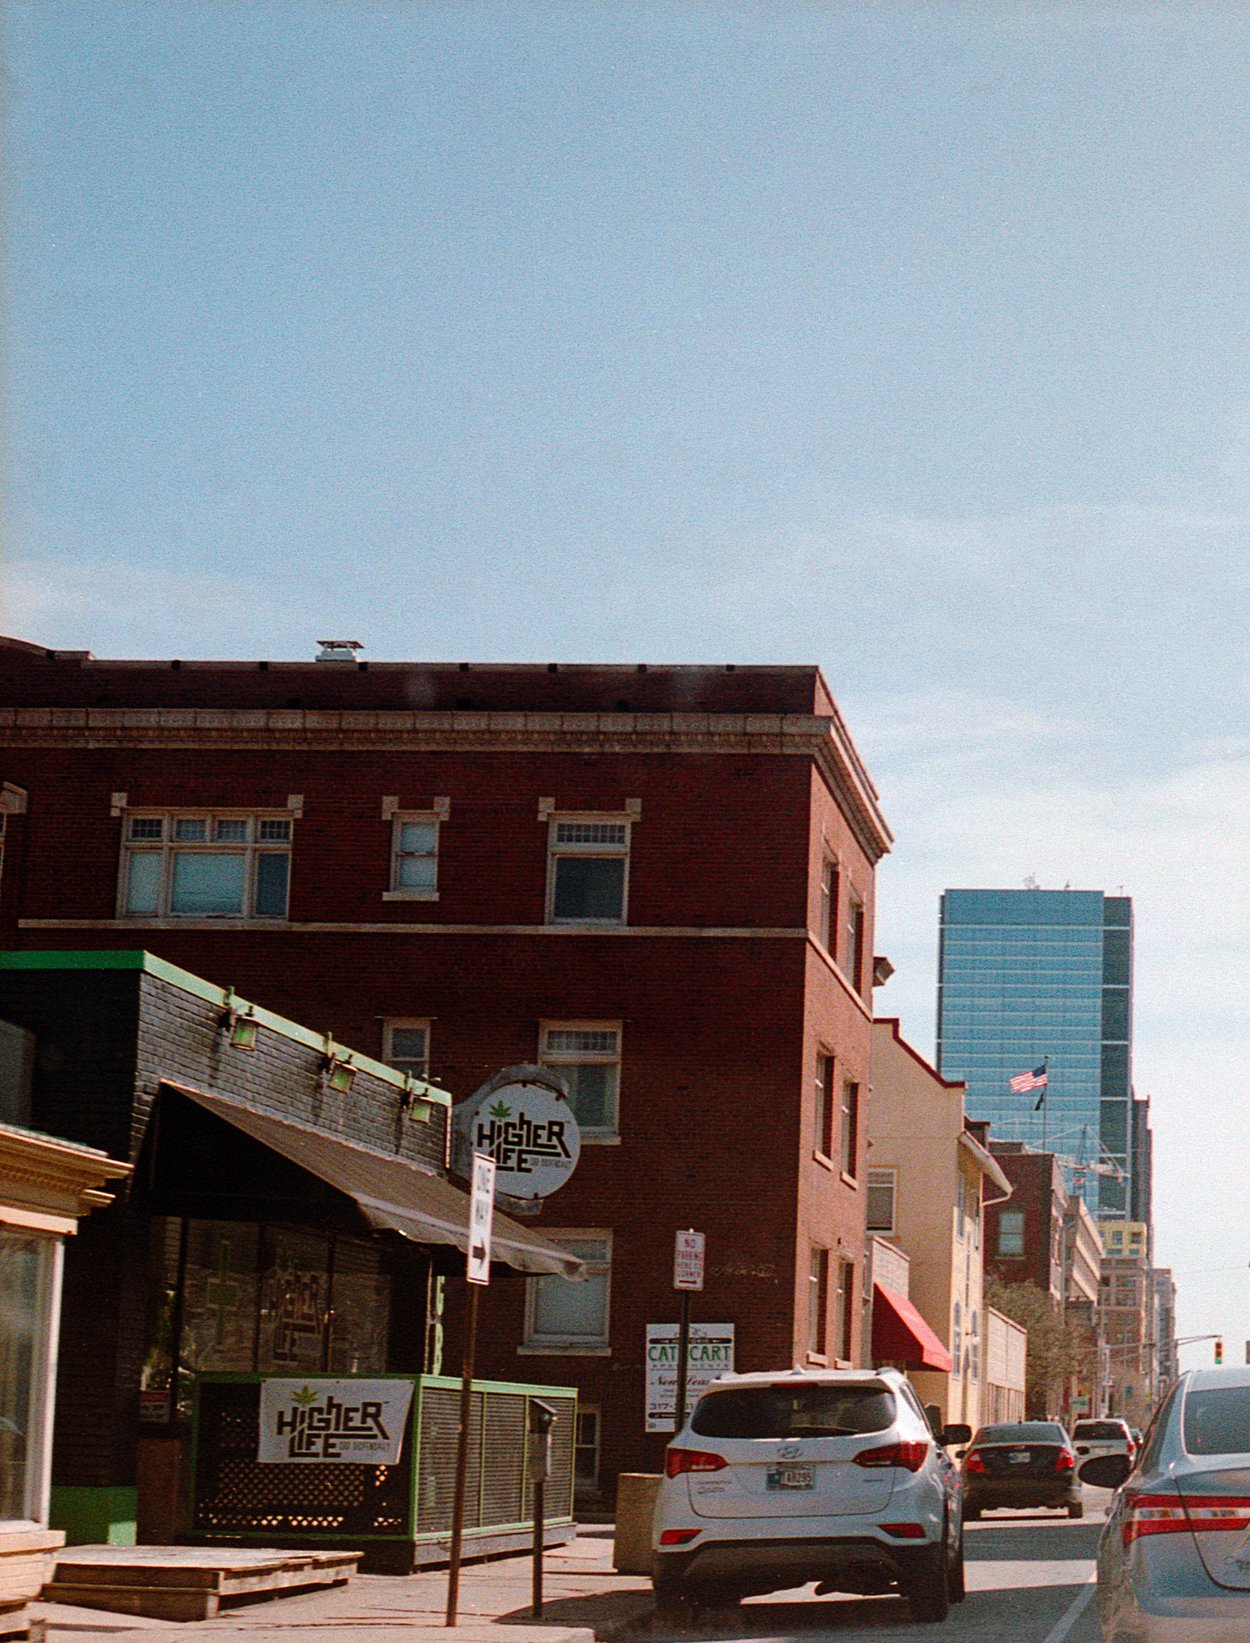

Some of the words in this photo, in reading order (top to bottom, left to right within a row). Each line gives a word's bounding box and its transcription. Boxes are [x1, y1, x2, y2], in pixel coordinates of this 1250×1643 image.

[685, 1238, 696, 1249] NO
[648, 1346, 731, 1361] CATCART
[289, 1426, 378, 1458] LIFE
